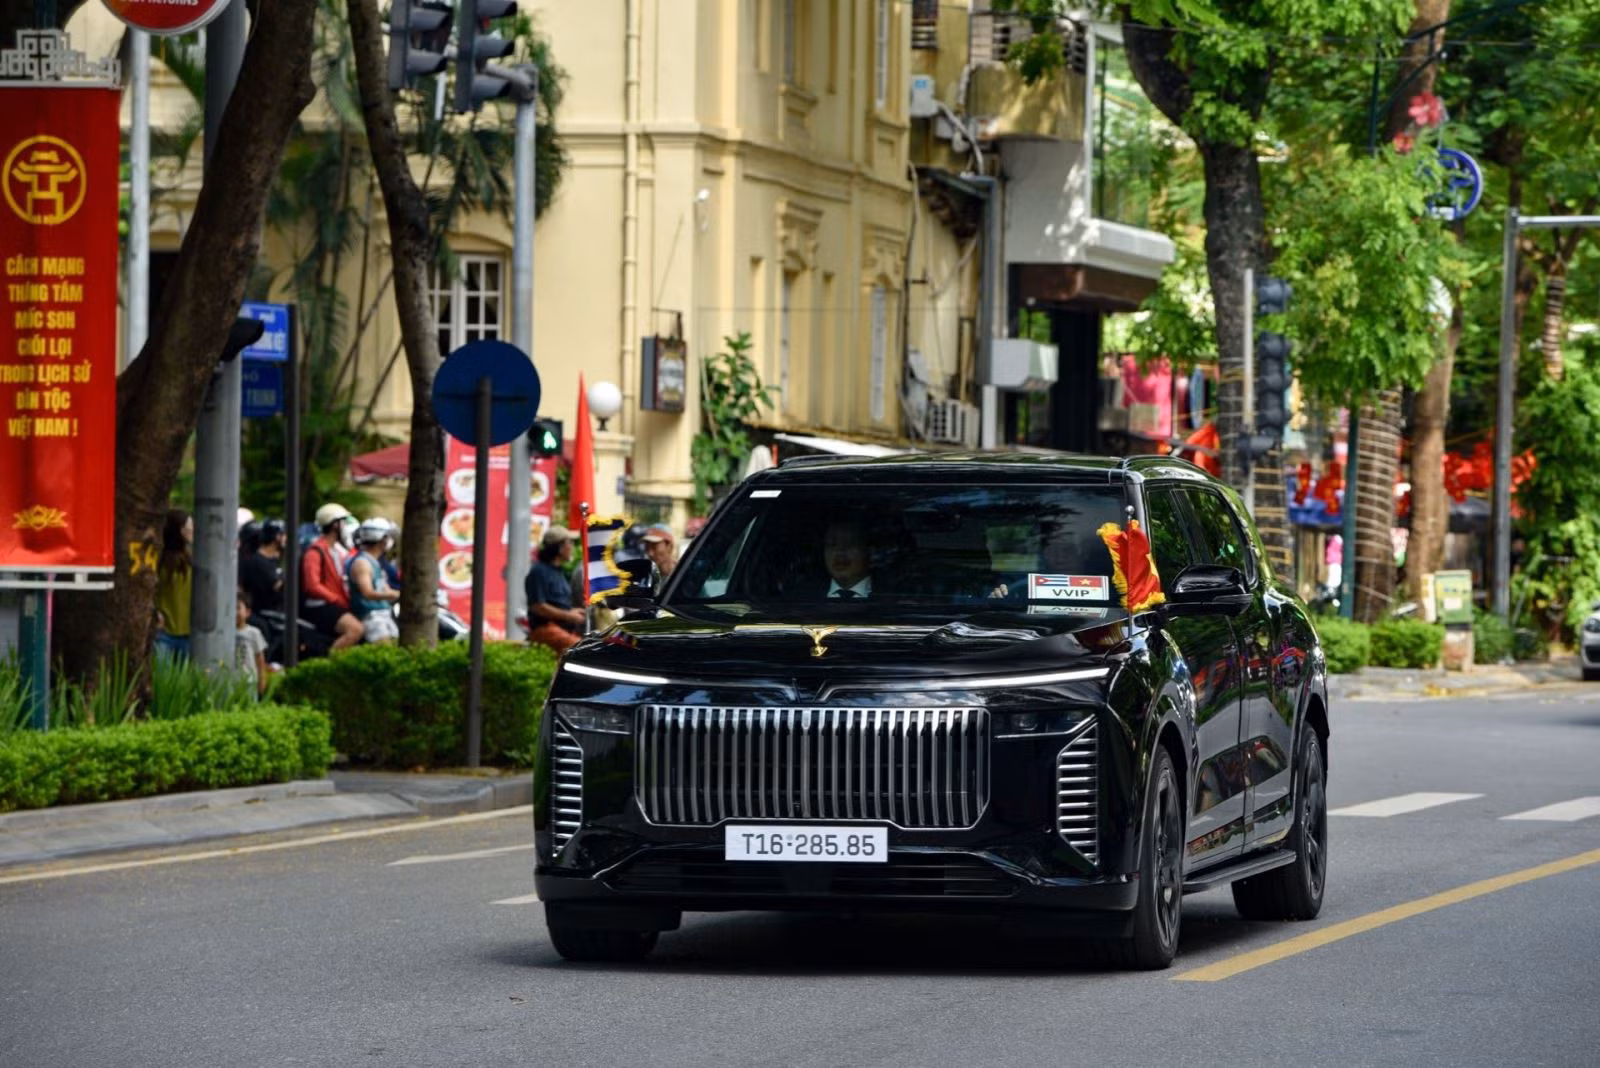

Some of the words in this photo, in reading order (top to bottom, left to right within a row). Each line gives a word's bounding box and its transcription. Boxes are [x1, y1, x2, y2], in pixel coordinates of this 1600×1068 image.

[42, 256, 85, 280] MẠNG
[52, 280, 83, 303] TÁM
[49, 337, 72, 360] LỌI
[38, 364, 71, 387] LỊCH
[43, 386, 72, 414] TỘC
[34, 417, 70, 438] NAM
[128, 541, 159, 577] 54
[1052, 588, 1090, 597] VVIP
